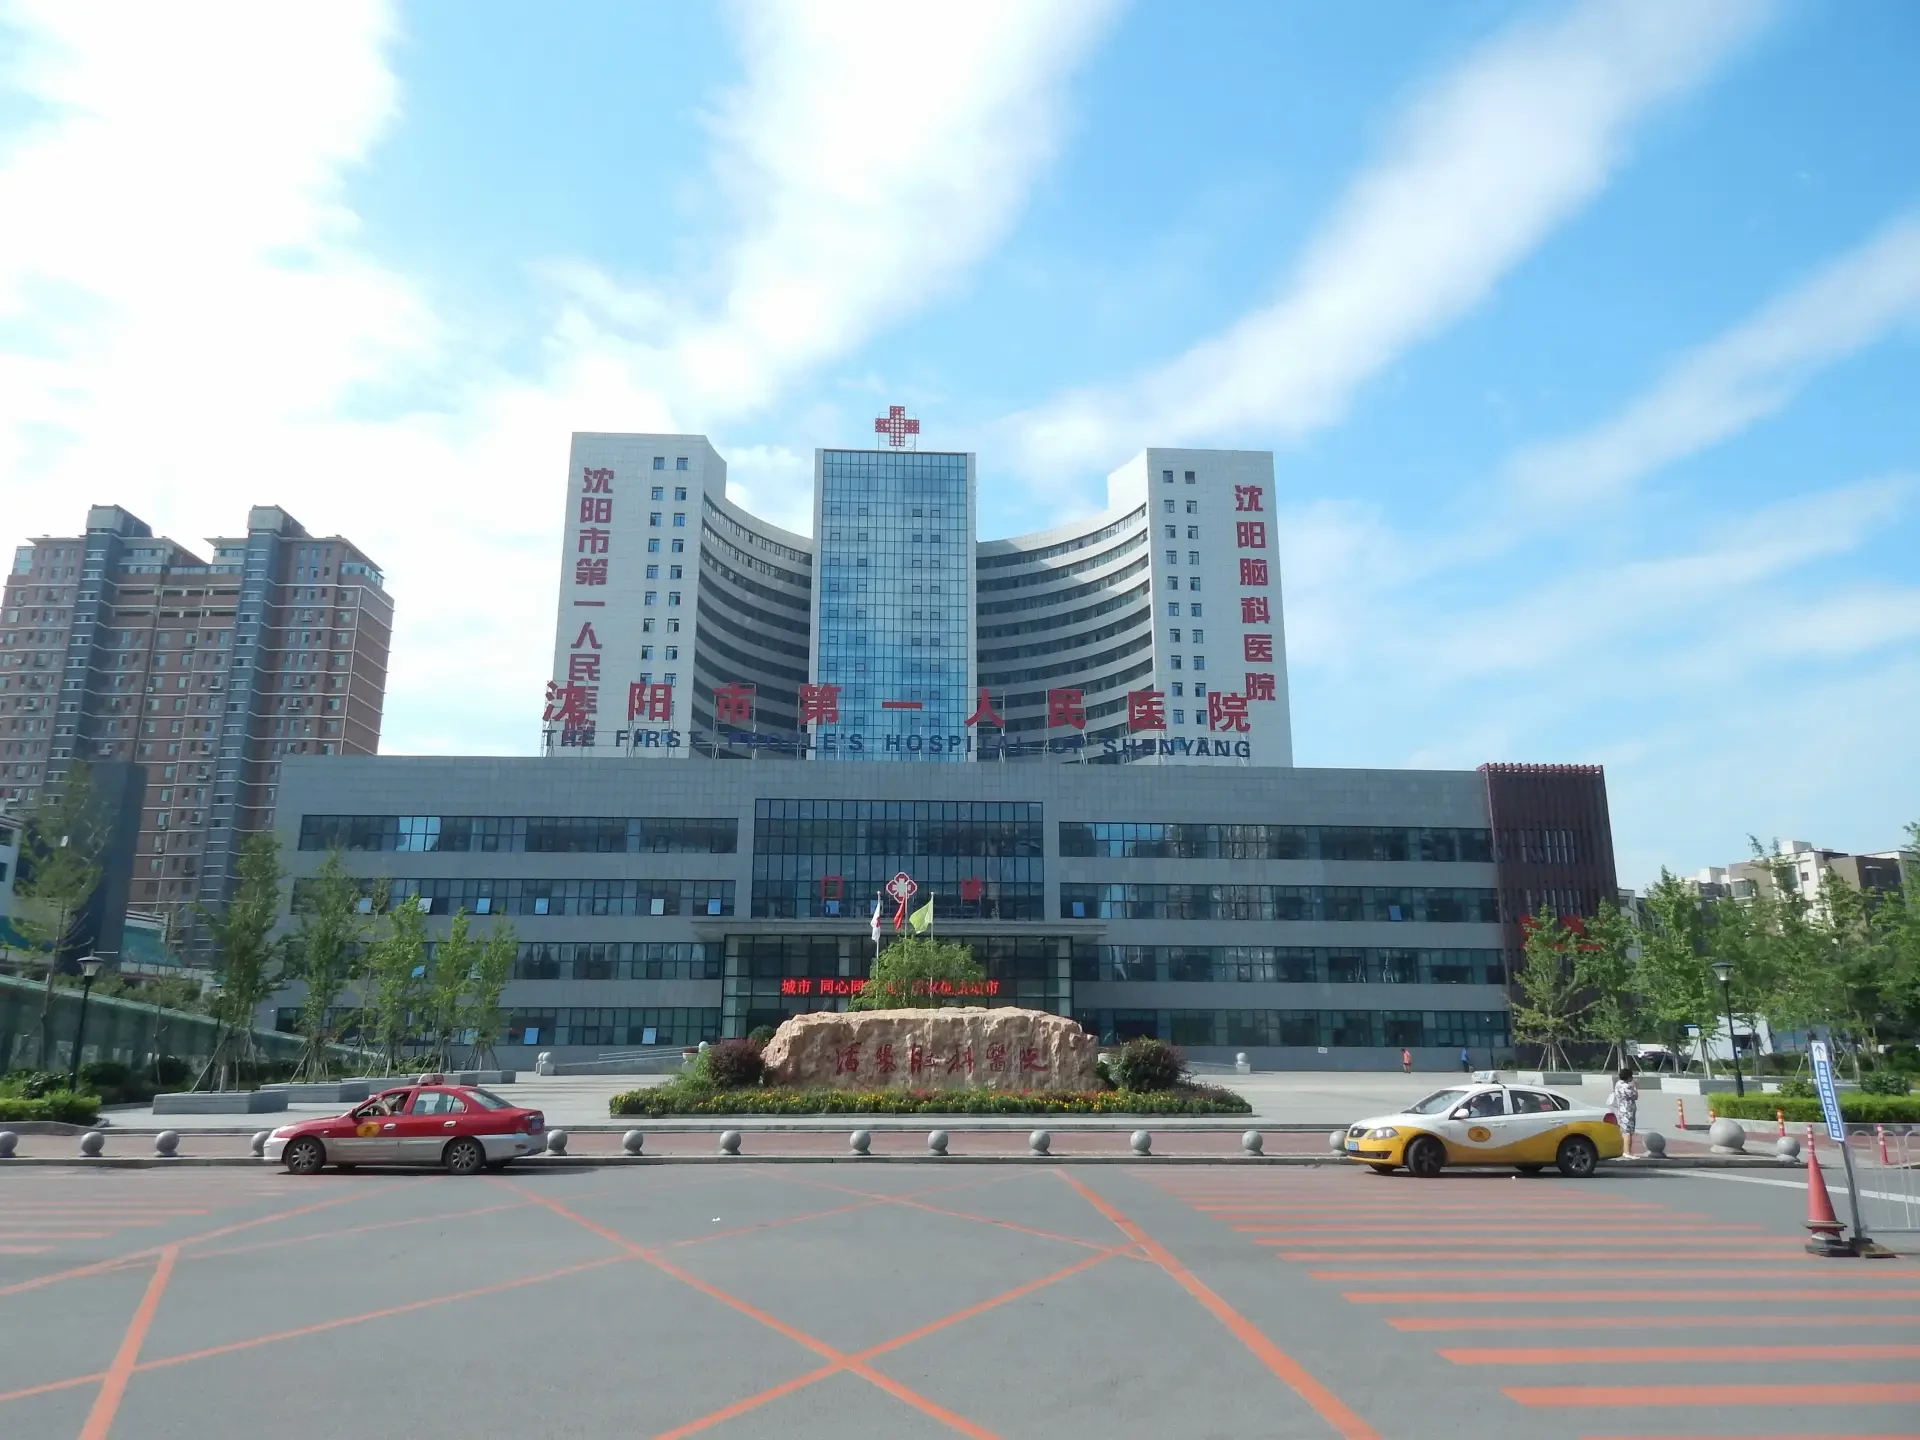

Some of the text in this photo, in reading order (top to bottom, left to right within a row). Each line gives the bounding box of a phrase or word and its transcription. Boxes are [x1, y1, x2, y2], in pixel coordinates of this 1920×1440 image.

[1234, 484, 1275, 701] 沈阳脑科医院
[542, 680, 1251, 732] 沈阳市第一人民医院
[543, 730, 595, 747] THE
[616, 730, 703, 748] FIRST
[1103, 737, 1251, 757] SHENYANG
